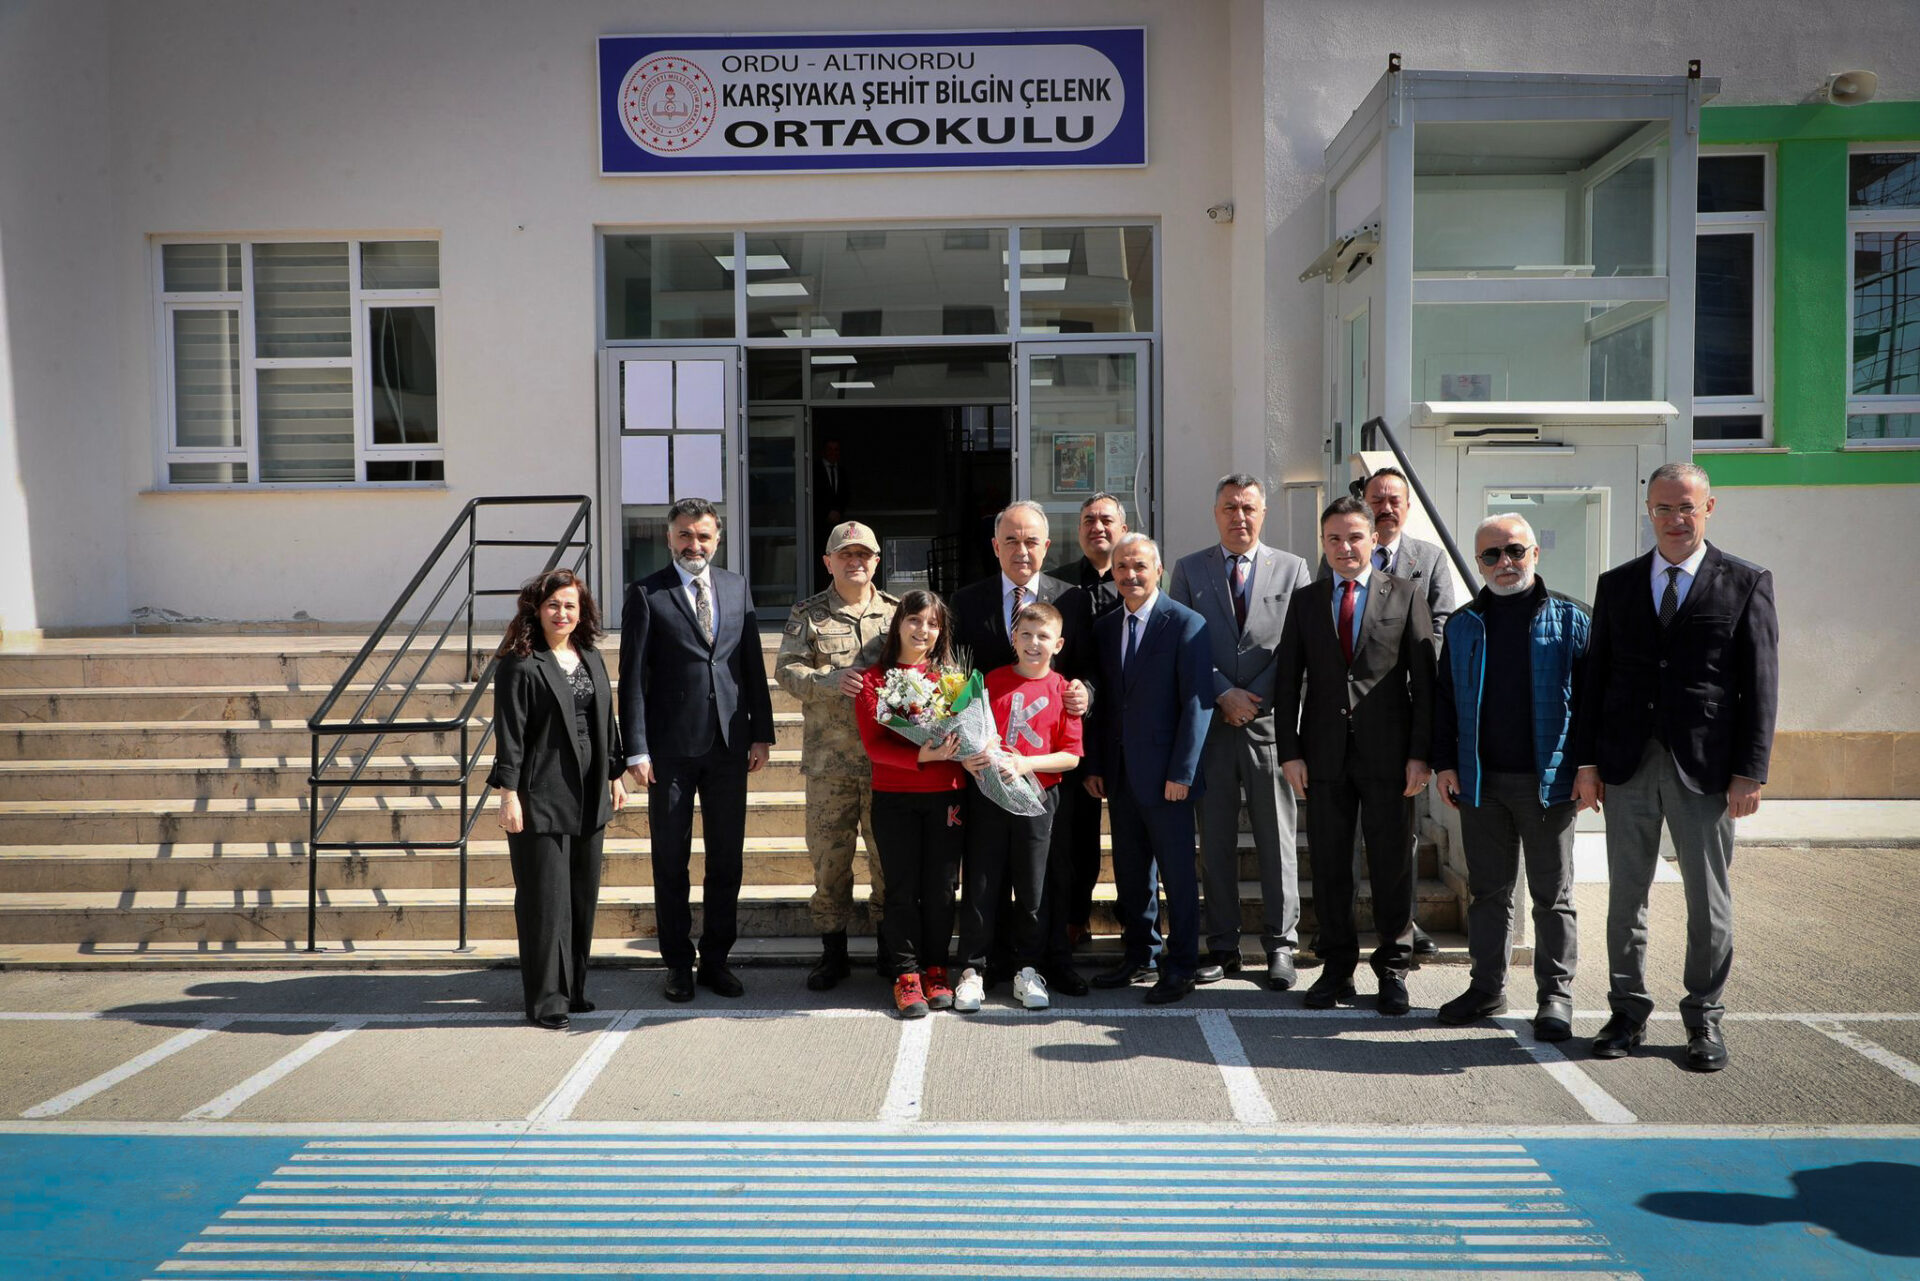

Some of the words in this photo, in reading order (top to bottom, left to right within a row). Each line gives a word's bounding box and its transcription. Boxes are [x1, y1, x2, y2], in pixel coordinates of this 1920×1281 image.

[722, 54, 799, 73] ORDU
[823, 52, 975, 72] ALTINORDU
[722, 82, 856, 113] KARŞIYAKA
[862, 75, 930, 111] ŞEHİT
[936, 73, 1013, 104] BİLGİN
[1020, 78, 1112, 109] ÇELENK
[724, 116, 1094, 149] ORTAOKULU
[1006, 692, 1049, 748] K
[947, 805, 962, 827] K
